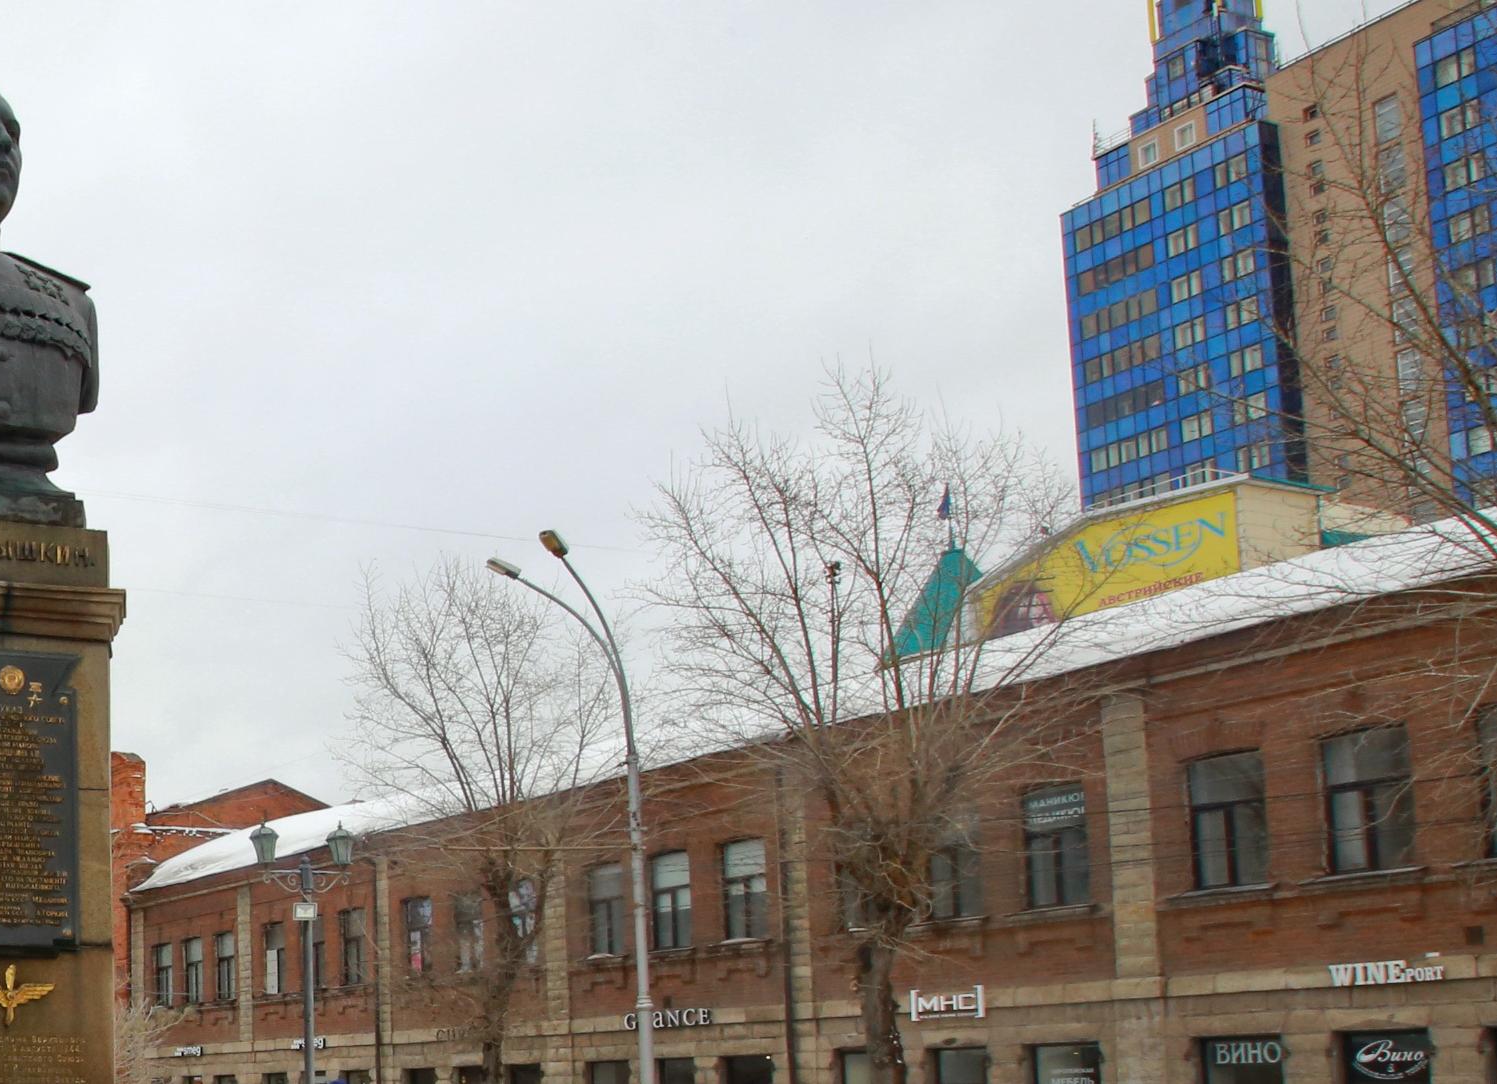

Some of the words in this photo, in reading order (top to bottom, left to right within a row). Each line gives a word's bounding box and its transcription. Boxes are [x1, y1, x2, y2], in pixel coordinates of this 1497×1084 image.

[1074, 511, 1226, 573] VOSSEN
[1098, 571, 1205, 607] АВСТРИЙСКИЕ
[1215, 1041, 1281, 1064] ВИНО
[1356, 1039, 1424, 1063] Вино
